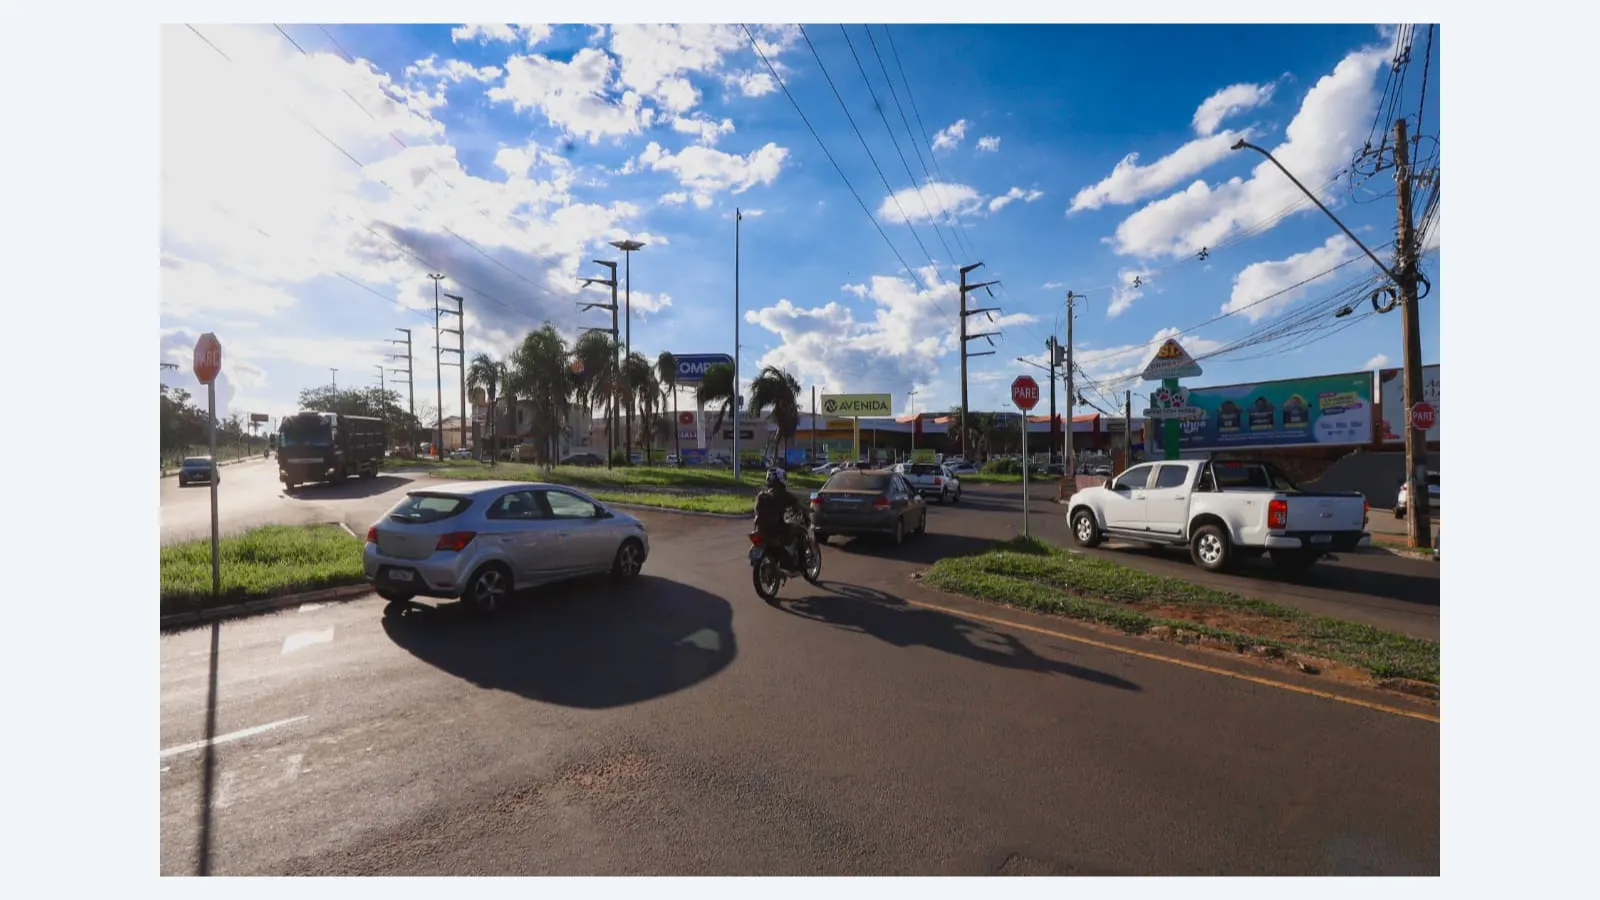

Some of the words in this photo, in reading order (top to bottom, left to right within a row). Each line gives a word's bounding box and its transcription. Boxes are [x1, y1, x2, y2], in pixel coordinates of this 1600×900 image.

[1014, 387, 1037, 399] PARE
[839, 400, 889, 411] AVENIDA
[1412, 411, 1434, 423] PARE
